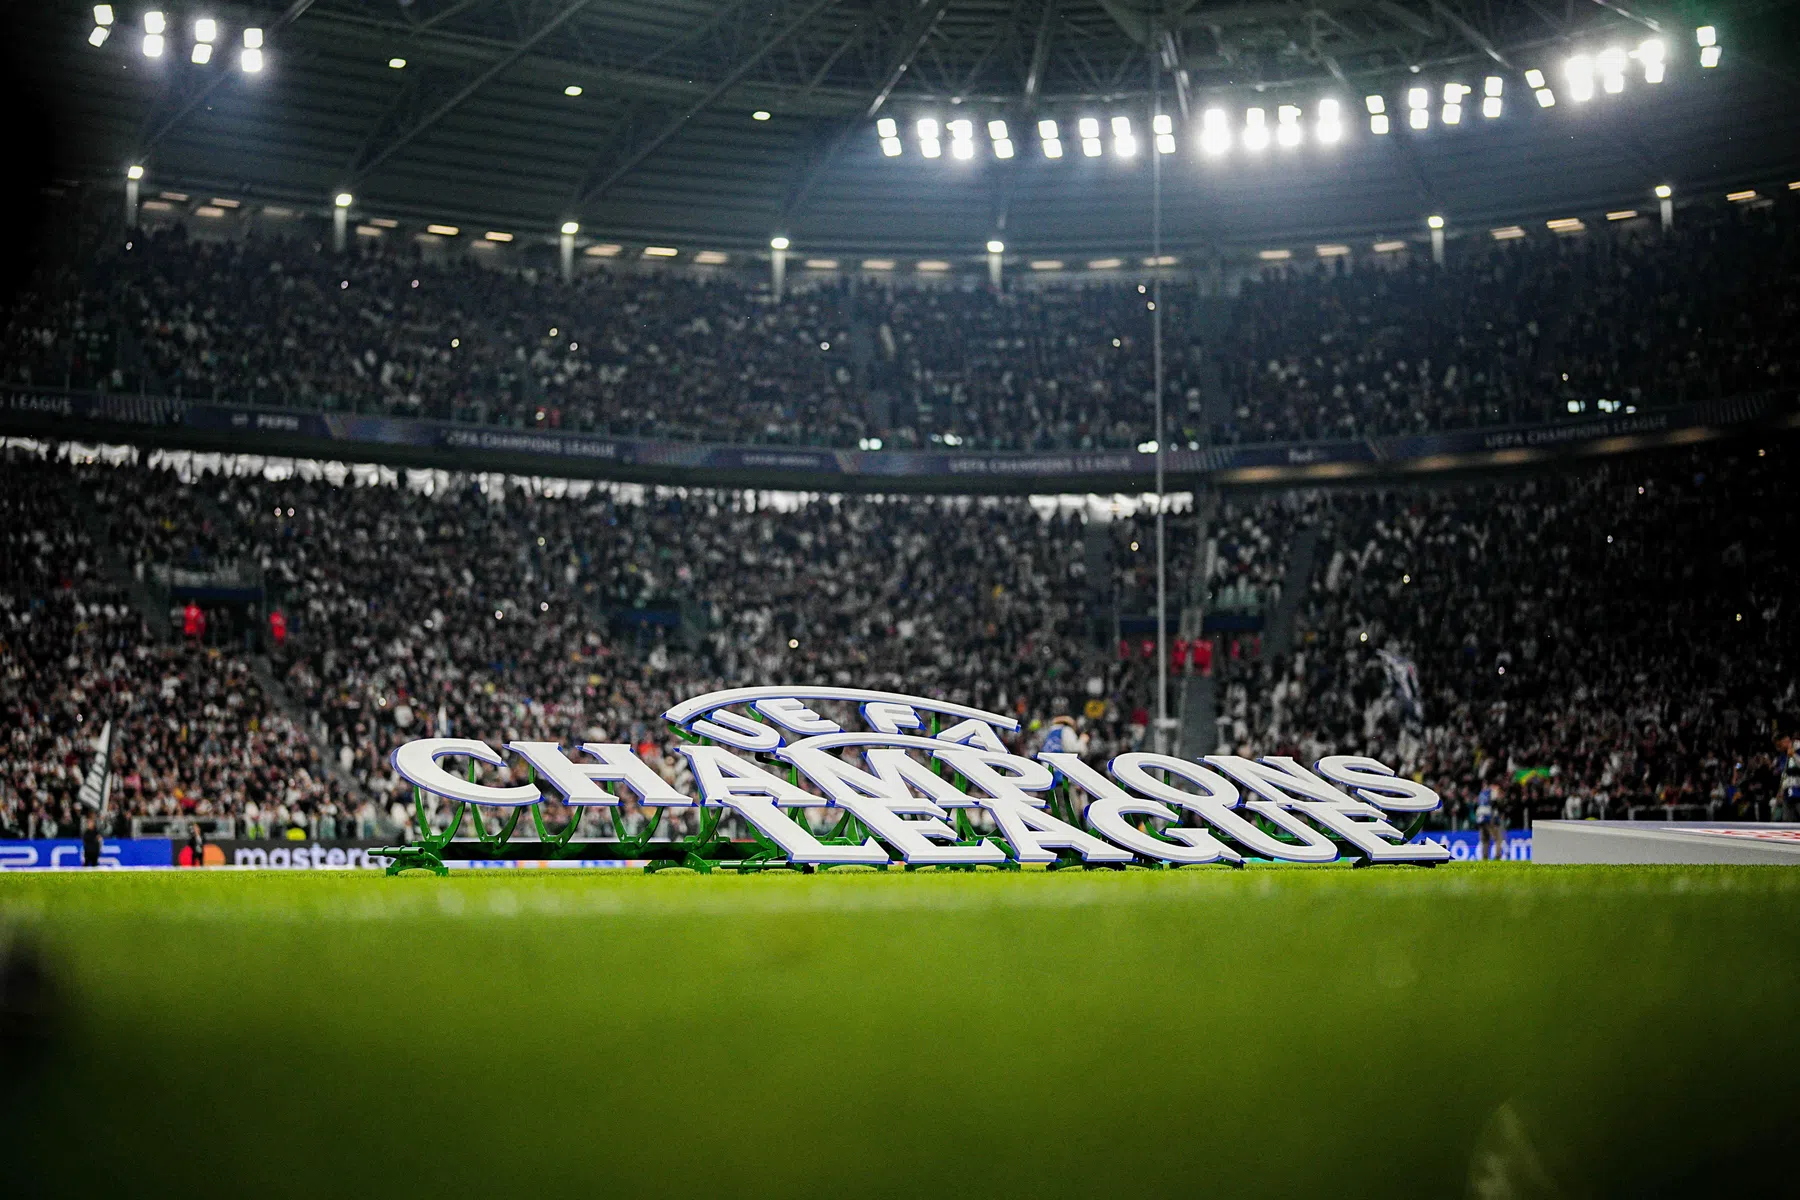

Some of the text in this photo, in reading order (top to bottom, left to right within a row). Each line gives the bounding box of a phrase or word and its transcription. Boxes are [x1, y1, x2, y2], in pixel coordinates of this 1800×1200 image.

[9, 393, 73, 412] LEAGUE
[684, 697, 1010, 754] UEFA
[391, 737, 1442, 812] CHAMPIONS
[234, 842, 396, 868] masterc
[721, 798, 1452, 865] LEAGUE
